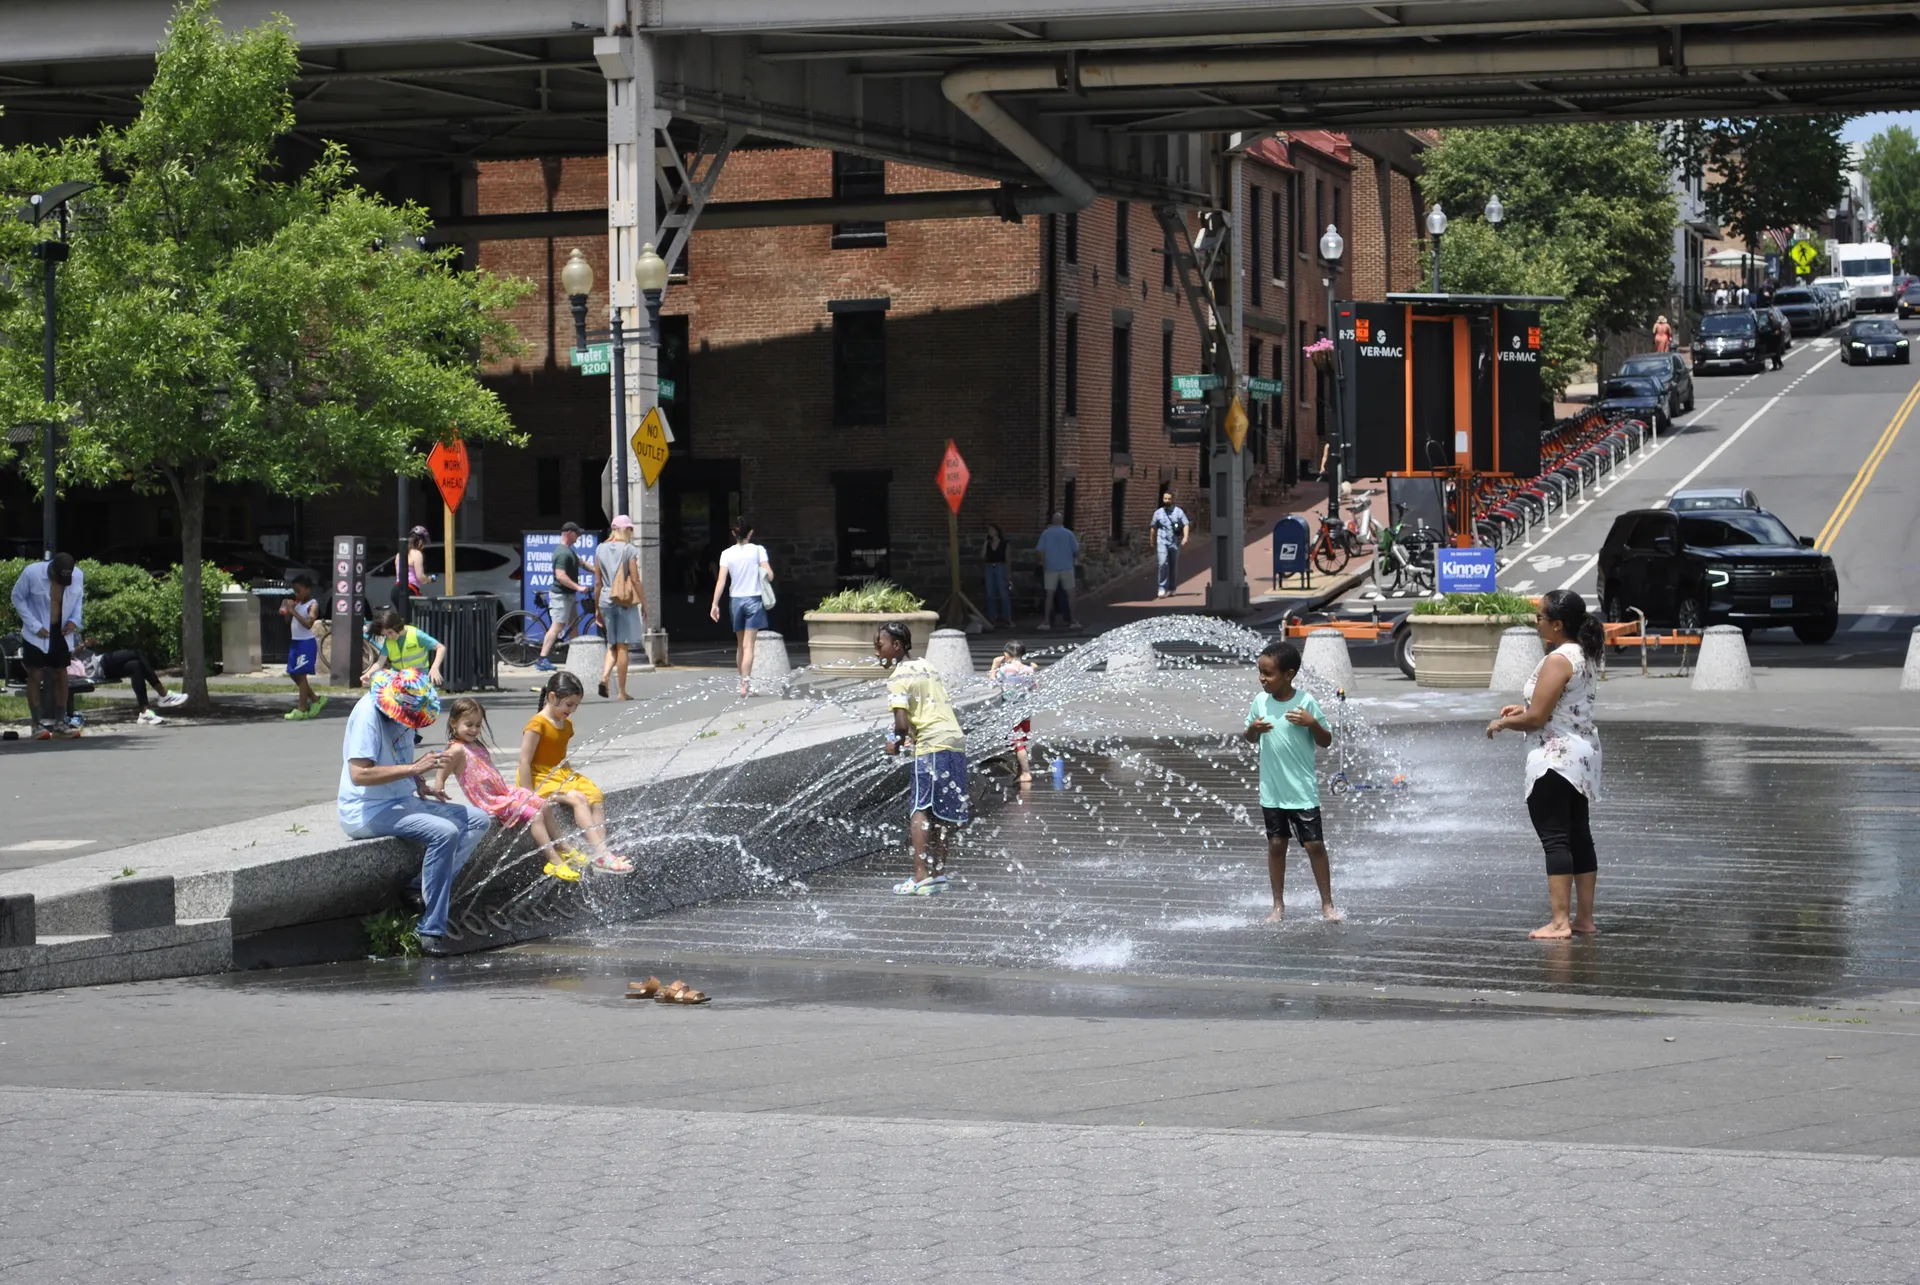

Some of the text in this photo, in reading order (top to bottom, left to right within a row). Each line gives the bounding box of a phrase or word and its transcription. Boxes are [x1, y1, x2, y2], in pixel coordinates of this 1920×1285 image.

[1339, 329, 1355, 340] R-75
[576, 348, 603, 363] Water
[1360, 346, 1403, 357] VER-MAC
[1497, 351, 1536, 362] VER-MAC
[582, 362, 607, 374] 3200
[1177, 378, 1200, 389] Wate
[1182, 389, 1203, 398] 3200
[647, 424, 658, 439] NO
[636, 441, 665, 461] OUTLET
[444, 460, 461, 471] WORK
[442, 477, 463, 489] AHEAD
[527, 535, 548, 544] EARLY
[549, 535, 561, 545] BIR
[527, 551, 552, 561] EVENIN
[527, 562, 533, 572] &
[1443, 561, 1491, 578] Kinney
